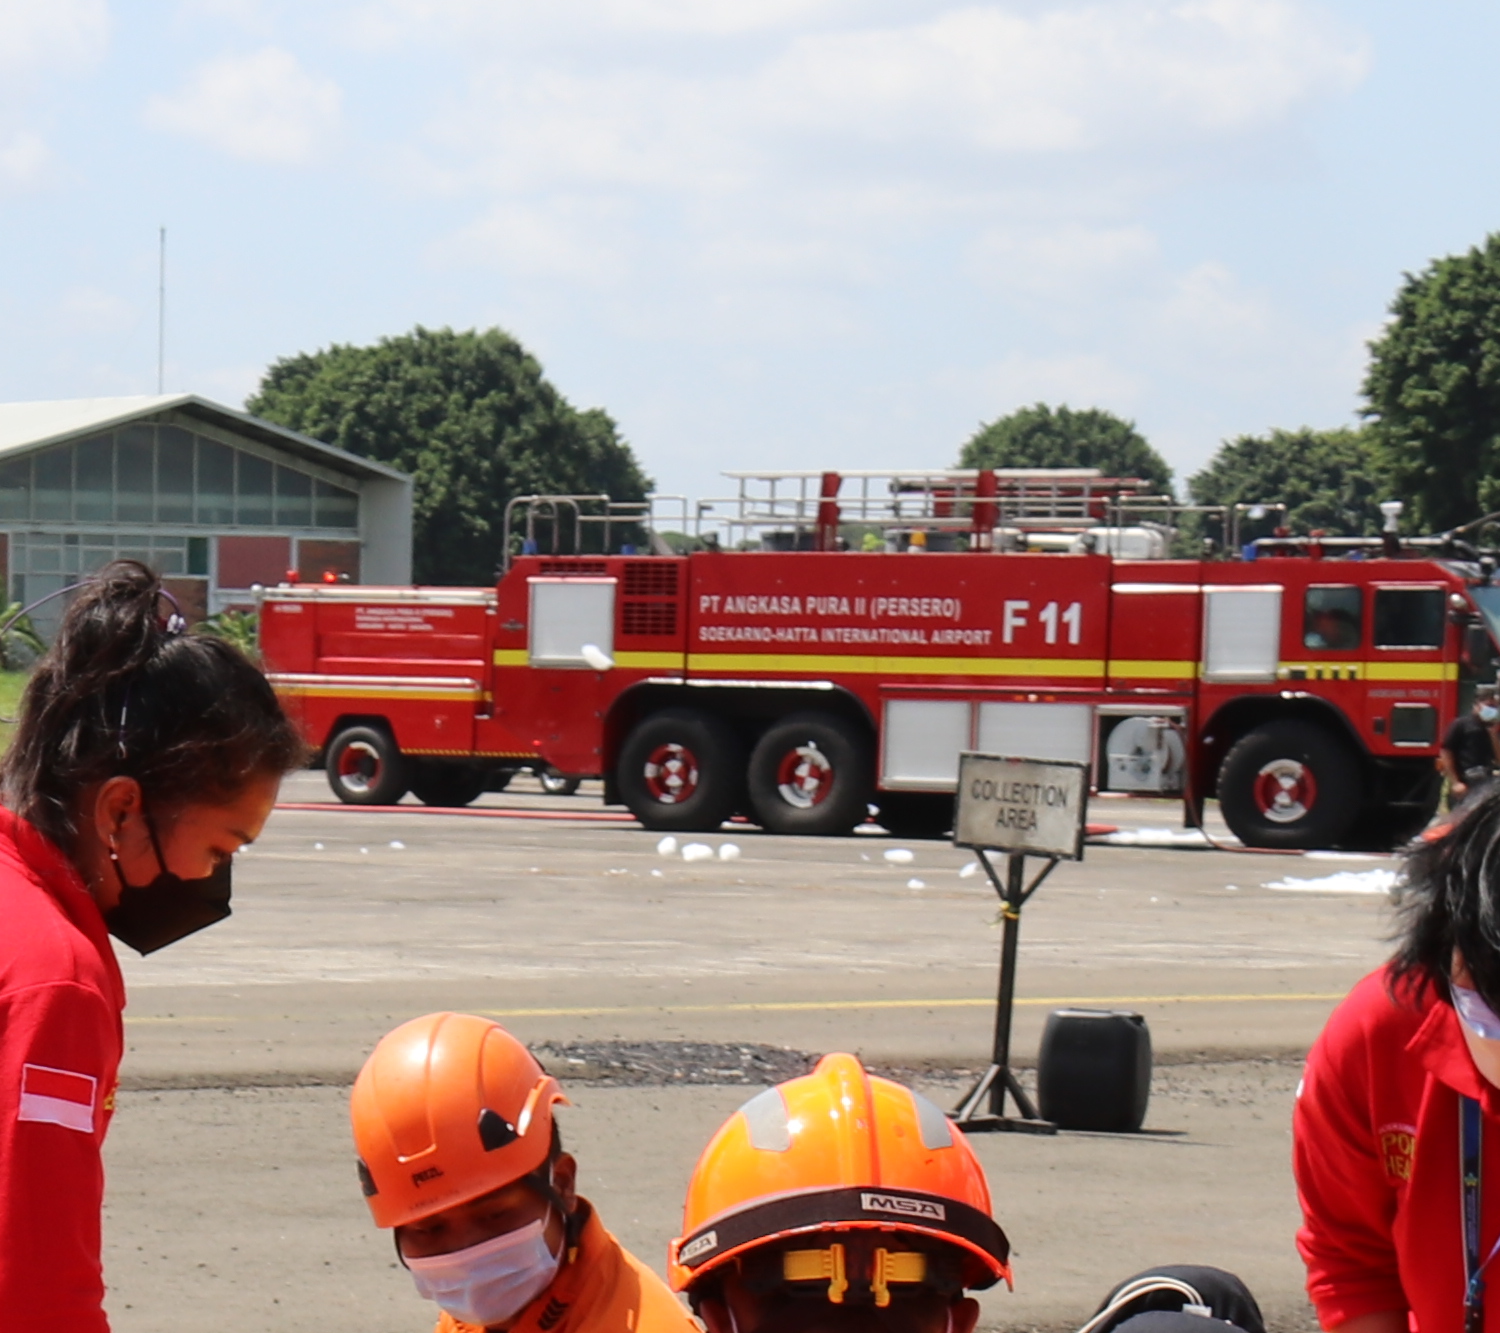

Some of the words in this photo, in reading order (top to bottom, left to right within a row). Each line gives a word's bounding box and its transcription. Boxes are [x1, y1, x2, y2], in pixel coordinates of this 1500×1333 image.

[700, 595, 720, 613] PT
[724, 595, 801, 614] ANGKASA
[806, 597, 850, 615] PURA
[854, 598, 866, 616] II
[870, 597, 962, 620] (PERSERO)
[1003, 600, 1029, 643] F
[1039, 601, 1082, 644] 11
[699, 625, 818, 643] SOEKARNO-HATTA
[821, 628, 928, 645] INTERNATIONAL
[931, 630, 992, 646] AIRPORT
[971, 778, 1068, 807] COLLECTION
[996, 807, 1038, 830] AREA
[868, 1197, 939, 1216] MSA
